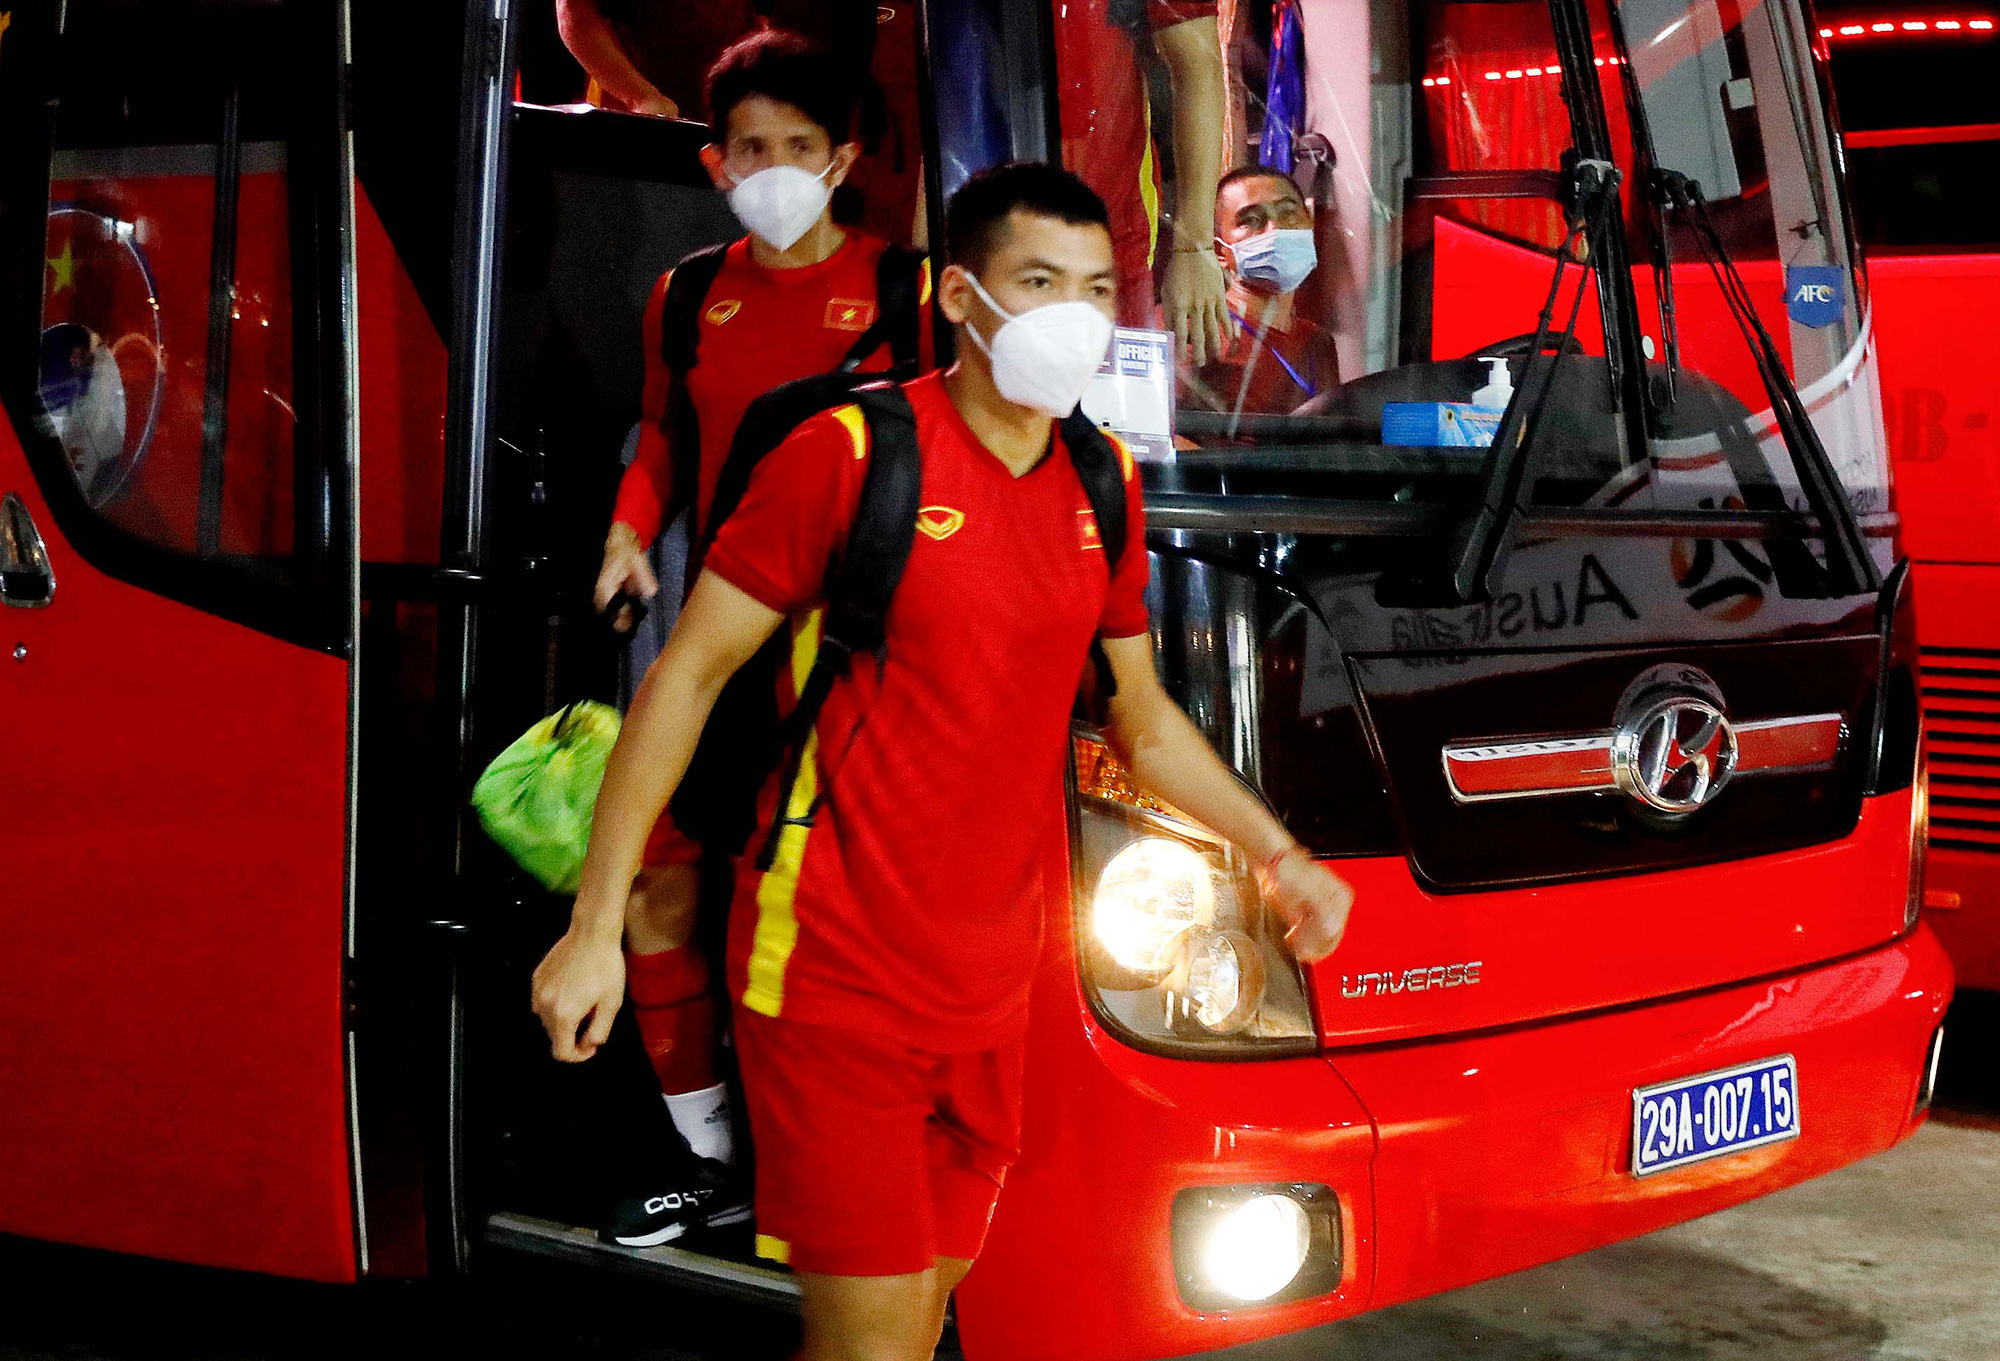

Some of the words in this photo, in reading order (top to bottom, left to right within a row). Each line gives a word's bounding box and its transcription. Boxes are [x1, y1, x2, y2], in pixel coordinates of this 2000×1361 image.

[1793, 285, 1832, 303] AFC
[1341, 961, 1483, 998] UNIVERSE
[1640, 1067, 1793, 1163] 29A-007.15
